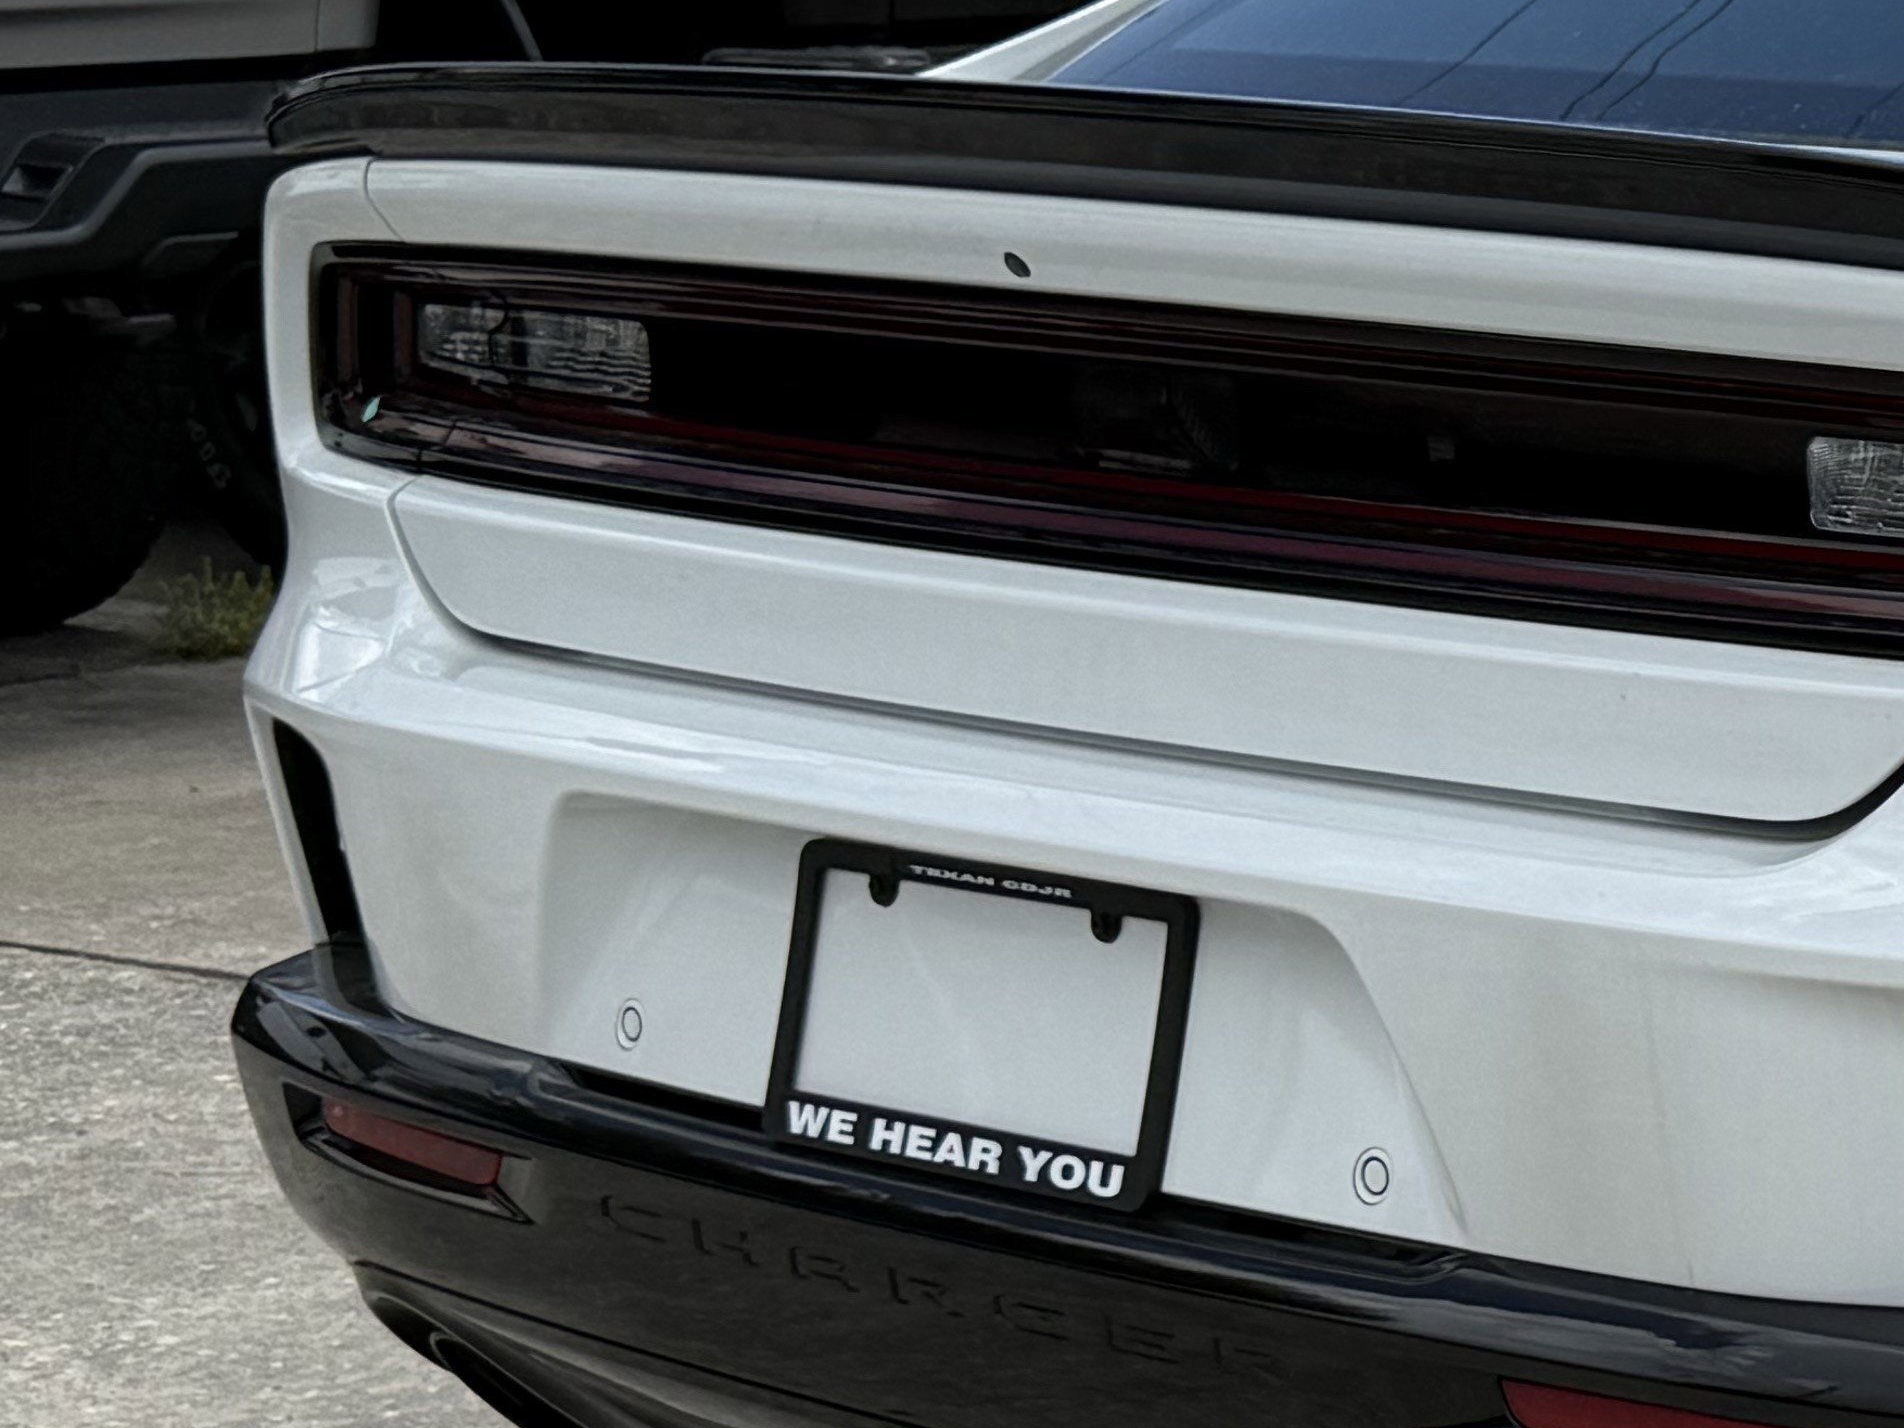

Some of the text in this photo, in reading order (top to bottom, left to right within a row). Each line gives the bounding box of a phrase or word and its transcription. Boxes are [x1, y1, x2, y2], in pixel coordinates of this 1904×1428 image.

[909, 864, 995, 886] TEXAN
[787, 1100, 1125, 1199] WE HEAR YOU
